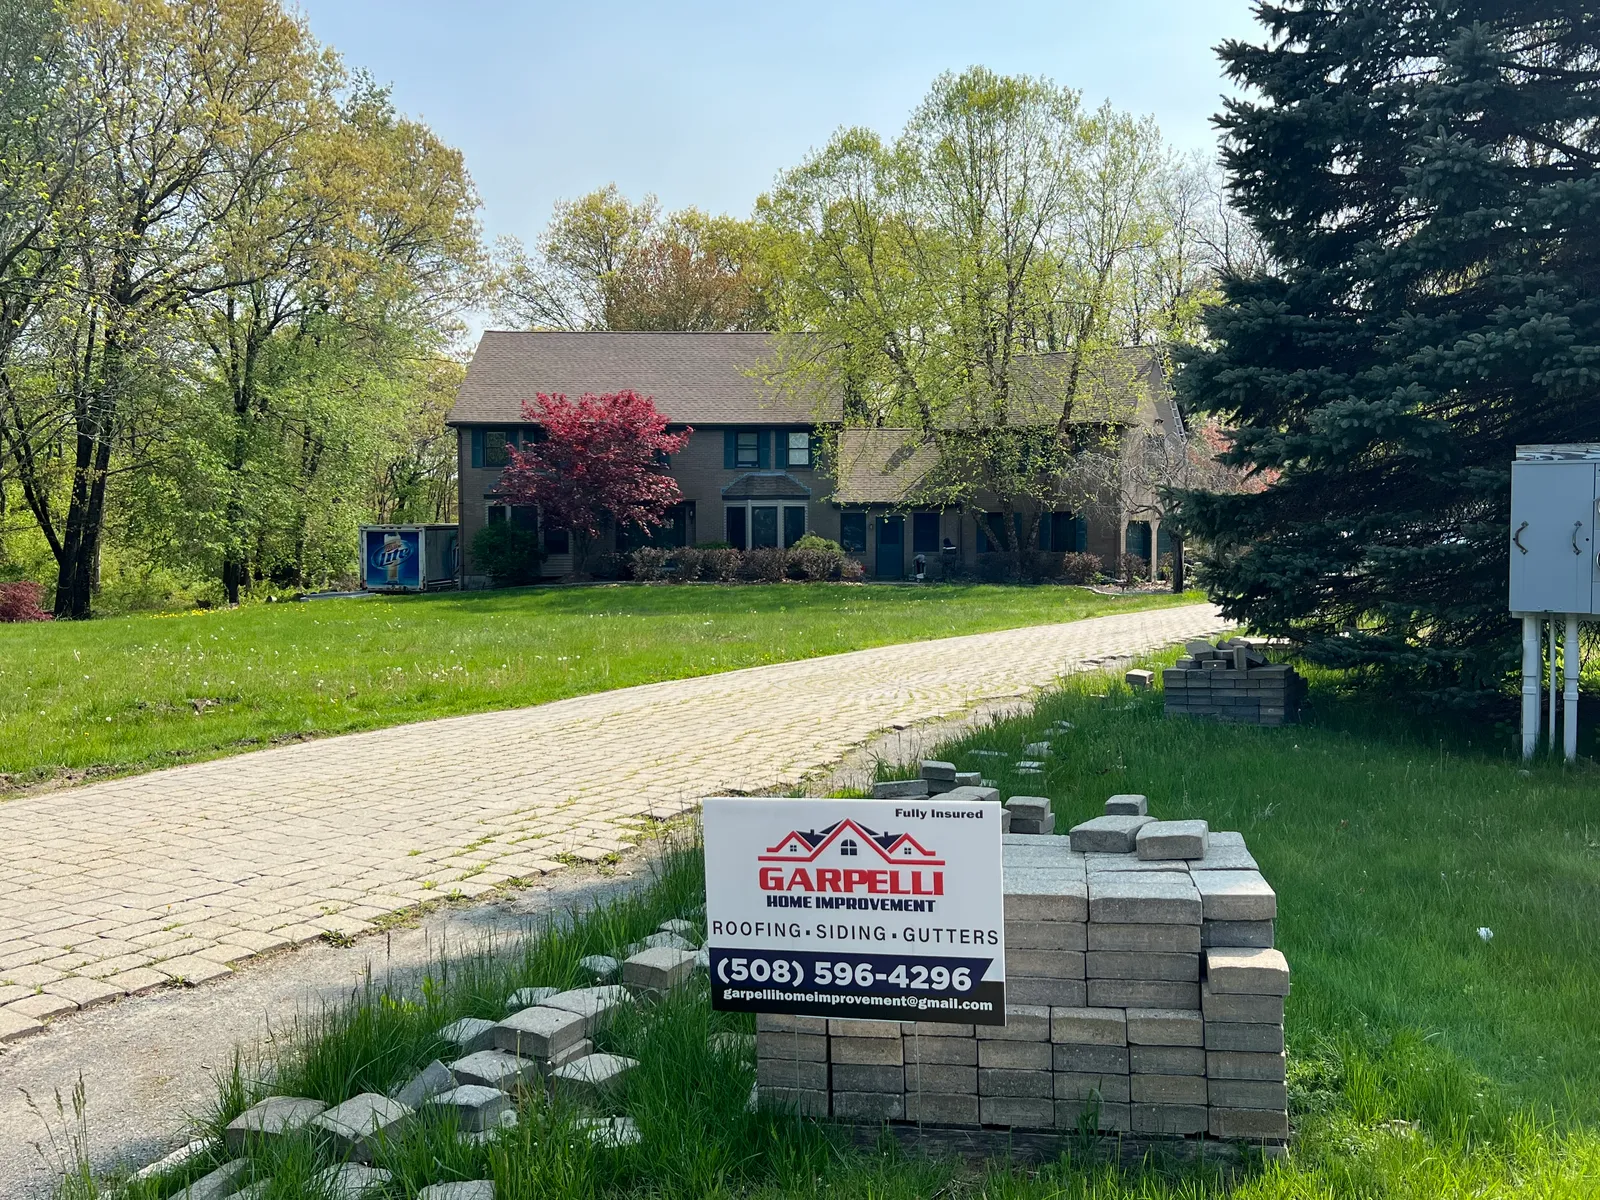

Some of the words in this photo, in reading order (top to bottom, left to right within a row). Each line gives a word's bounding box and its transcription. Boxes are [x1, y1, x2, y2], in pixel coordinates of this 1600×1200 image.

[895, 808, 927, 820] Fully
[931, 809, 984, 819] Insured
[758, 867, 945, 896] GARPELLI
[766, 895, 813, 909] HOME
[815, 896, 936, 913] IMPROVEMENT
[712, 920, 802, 938] ROOFING
[816, 924, 887, 941] SIDING
[903, 928, 999, 945] GUTTERS
[717, 957, 805, 987] (508)
[813, 961, 973, 991] 596-4296
[723, 988, 993, 1012] garpellihomeimprovement@gmail.com
